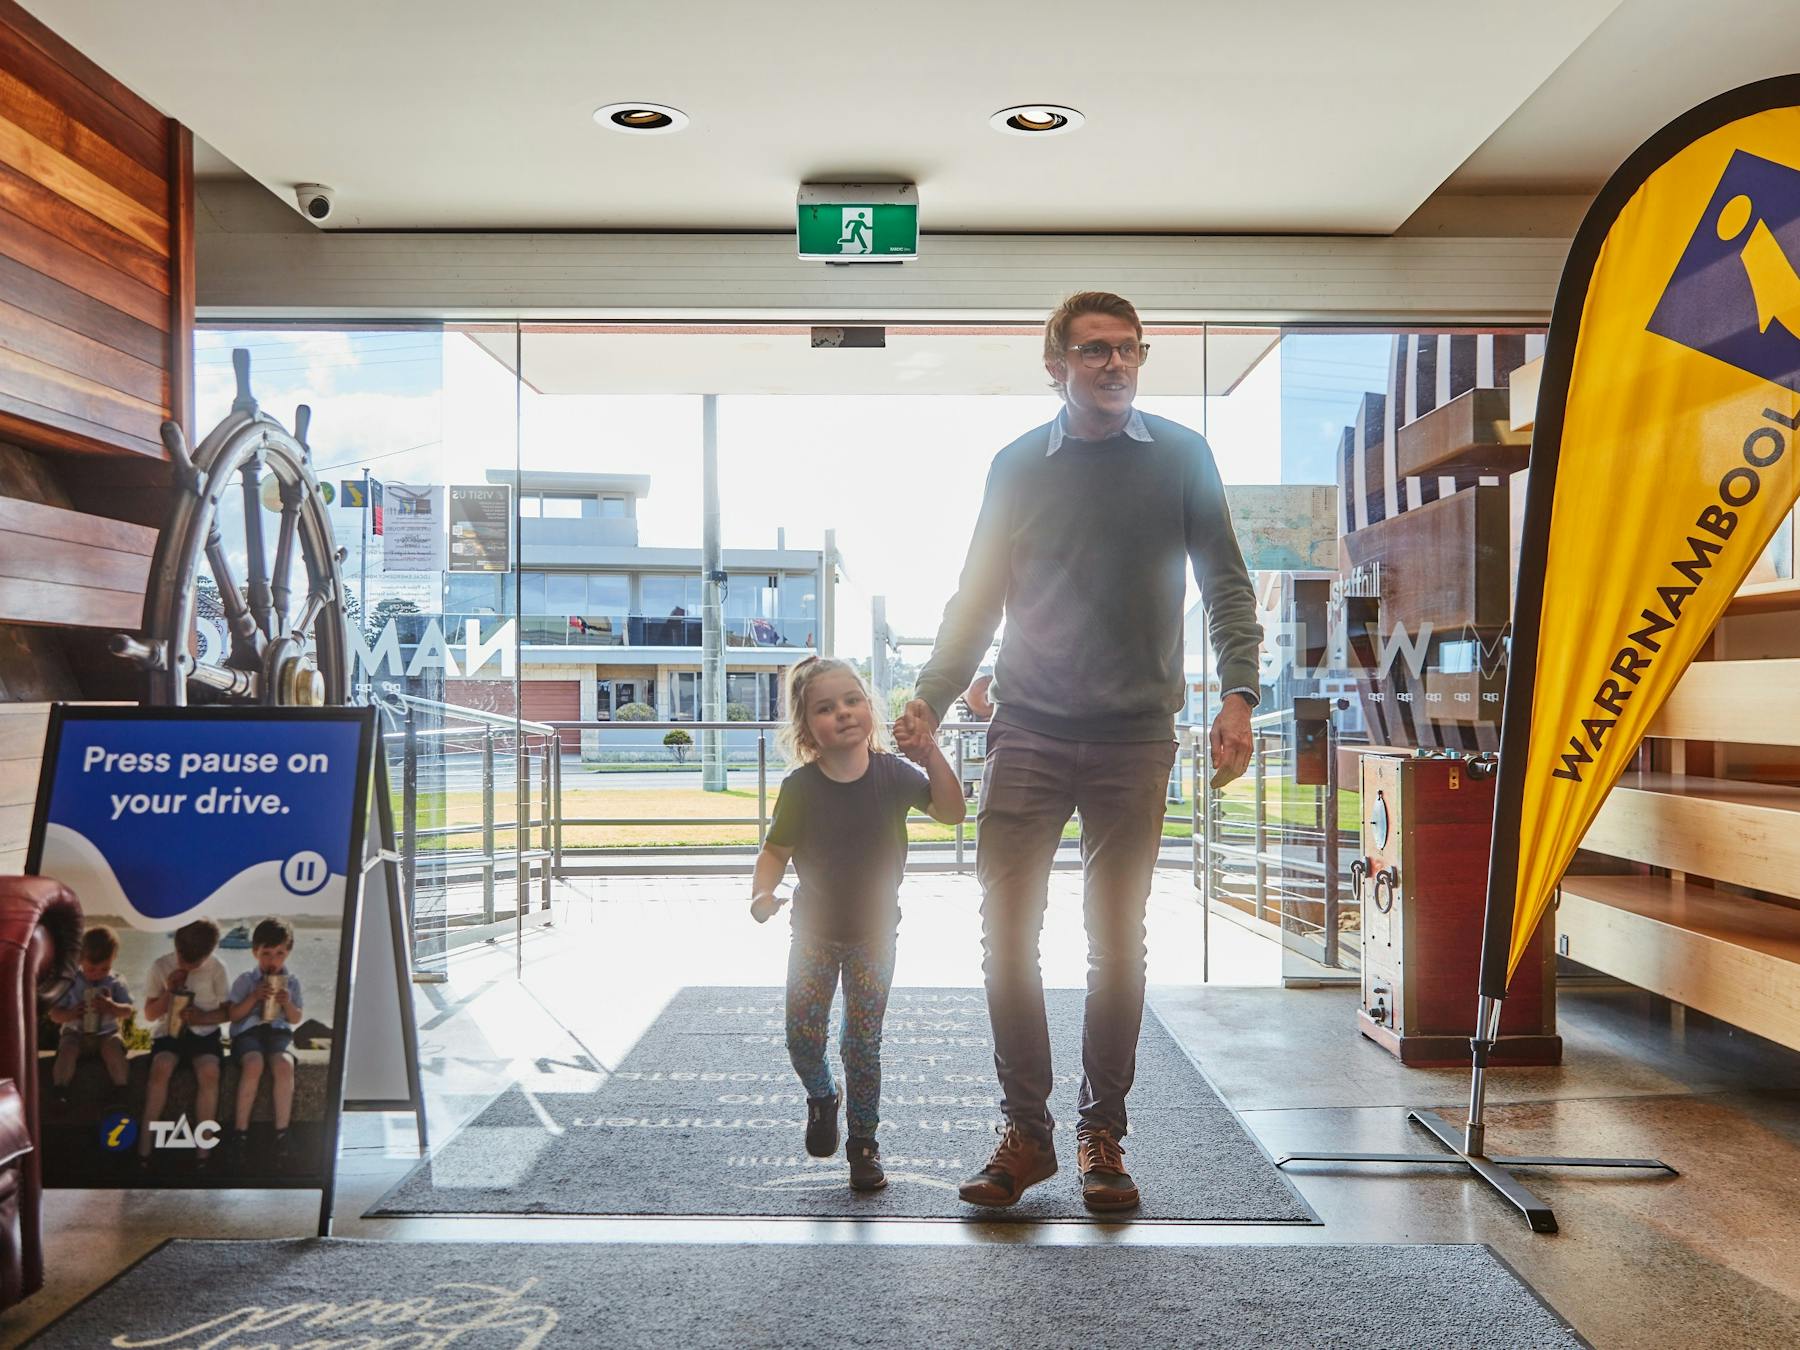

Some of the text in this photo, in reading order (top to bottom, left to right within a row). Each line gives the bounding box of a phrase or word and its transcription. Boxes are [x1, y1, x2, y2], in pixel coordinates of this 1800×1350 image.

[1552, 407, 1800, 783] WARRNAMBOOL
[83, 746, 329, 779] Press pause on
[110, 787, 291, 820] your drive.
[149, 1112, 221, 1149] TAC
